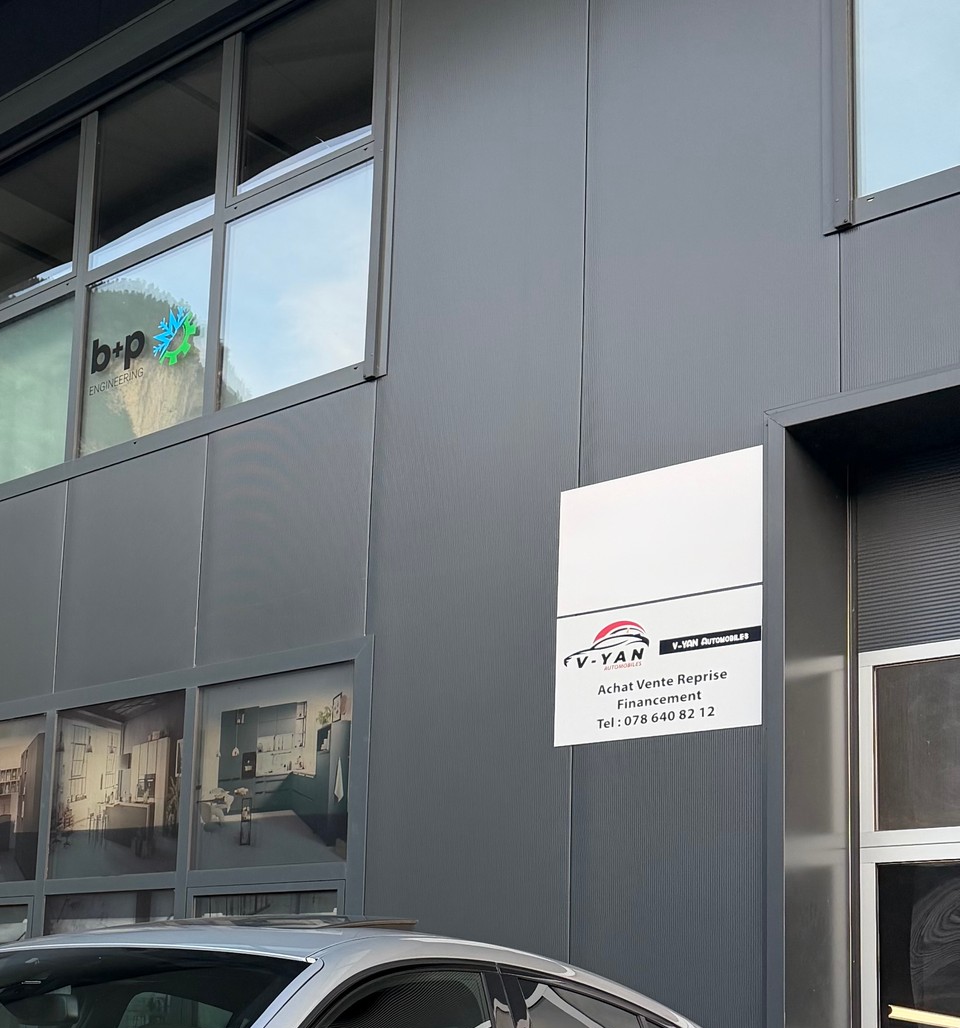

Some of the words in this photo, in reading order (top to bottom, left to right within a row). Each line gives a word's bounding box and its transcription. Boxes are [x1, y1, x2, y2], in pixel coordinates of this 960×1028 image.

[91, 330, 145, 374] b+p
[89, 367, 144, 396] ENGINEERING
[603, 661, 642, 671] AUTOMOBILES
[598, 682, 634, 695] Achat
[637, 677, 674, 690] Vente
[678, 670, 728, 685] Reprise
[617, 691, 702, 709] Financement
[597, 717, 615, 729] Tel
[624, 714, 648, 726] 078
[651, 711, 675, 723] 640
[679, 708, 695, 720] 82
[700, 706, 715, 717] 12
